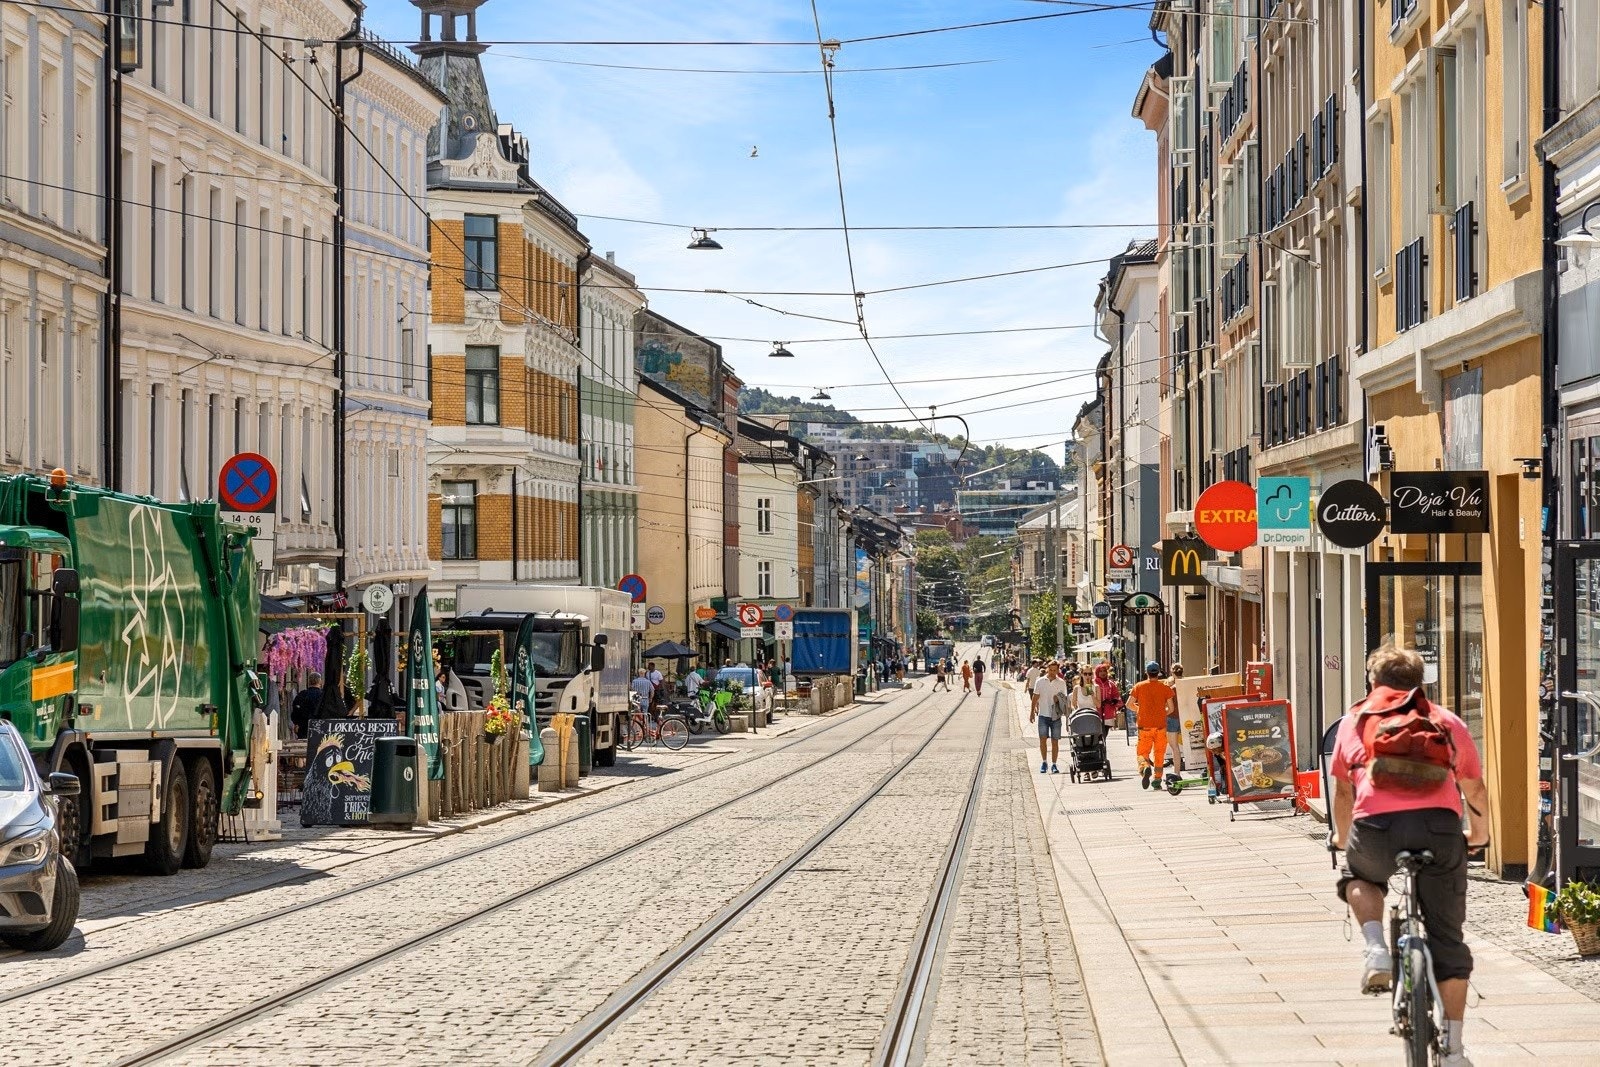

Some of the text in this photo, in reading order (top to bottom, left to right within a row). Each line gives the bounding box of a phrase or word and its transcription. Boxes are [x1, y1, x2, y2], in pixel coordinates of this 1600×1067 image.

[1450, 486, 1482, 507] Vu
[232, 514, 241, 523] 14
[248, 515, 261, 524] 06
[1200, 509, 1257, 524] EXTRA
[1431, 509, 1482, 518] Hair & Beauty
[1146, 557, 1159, 570] RI
[328, 722, 366, 732] LØKKAS
[368, 722, 398, 732] BESTE
[354, 732, 374, 744] Fri
[1236, 730, 1246, 742] 3
[1271, 726, 1282, 738] 2
[345, 744, 374, 763] Chic
[352, 812, 366, 820] HOT
